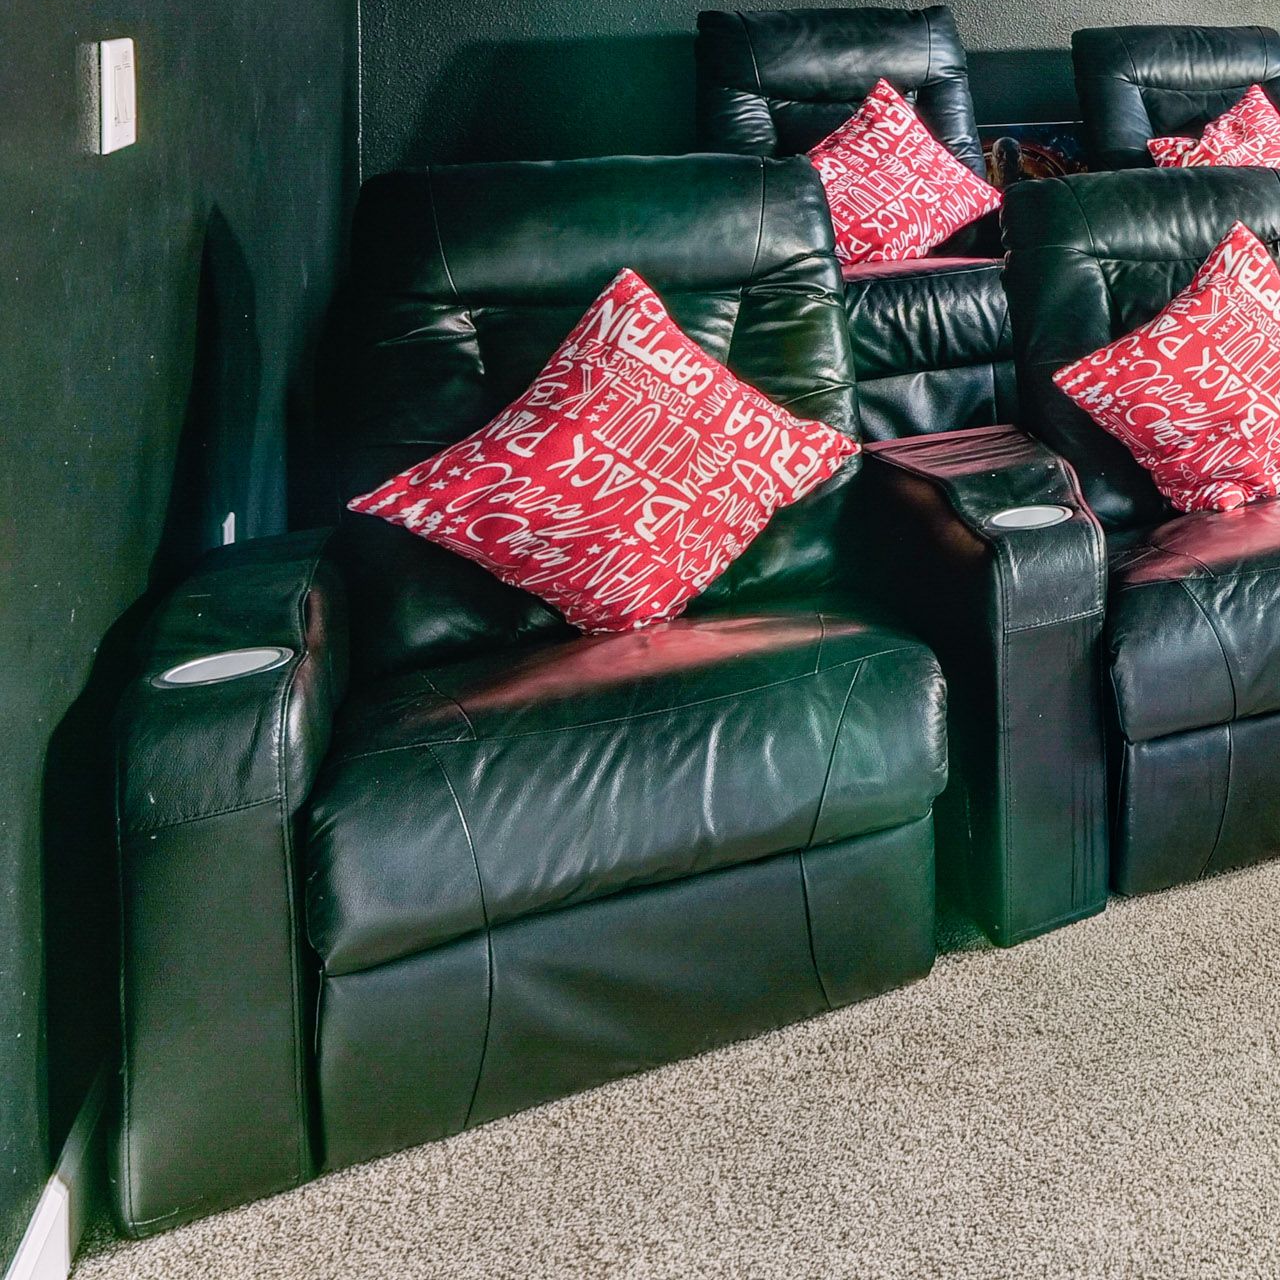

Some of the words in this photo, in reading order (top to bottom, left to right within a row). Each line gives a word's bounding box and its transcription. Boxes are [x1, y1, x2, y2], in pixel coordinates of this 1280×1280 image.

[861, 178, 941, 237] BLACK
[576, 298, 714, 396] CAPTAIN
[549, 364, 701, 479] HULK
[1115, 360, 1236, 430] Marvel
[1183, 347, 1280, 439] BLACK
[446, 463, 625, 540] Marvel
[546, 434, 691, 542] BLACK
[660, 433, 737, 502] SPIDEY
